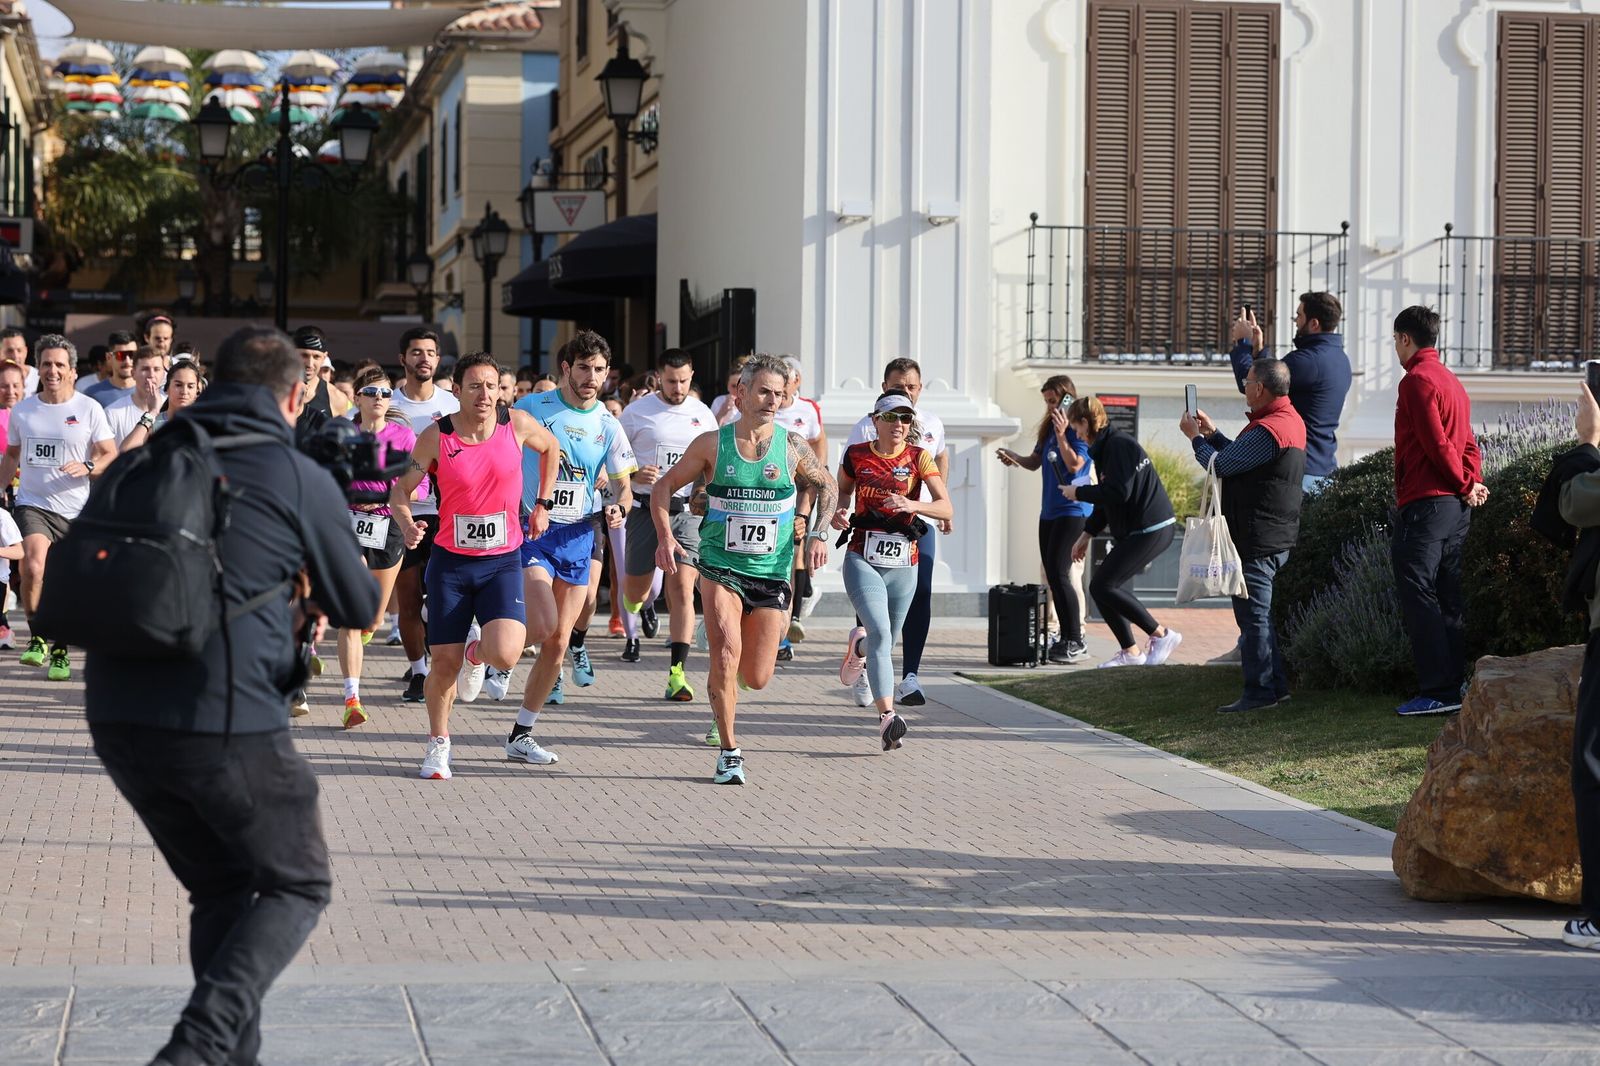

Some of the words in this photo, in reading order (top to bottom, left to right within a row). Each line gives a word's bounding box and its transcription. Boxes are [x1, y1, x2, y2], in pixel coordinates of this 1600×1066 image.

[35, 444, 56, 458] 501
[553, 489, 575, 506] 161
[726, 488, 776, 500] ATLETISMO
[719, 499, 782, 513] TORREMOLINOS
[356, 519, 374, 537] 84
[466, 522, 496, 539] 240
[740, 524, 767, 542] 179
[875, 540, 902, 557] 425
